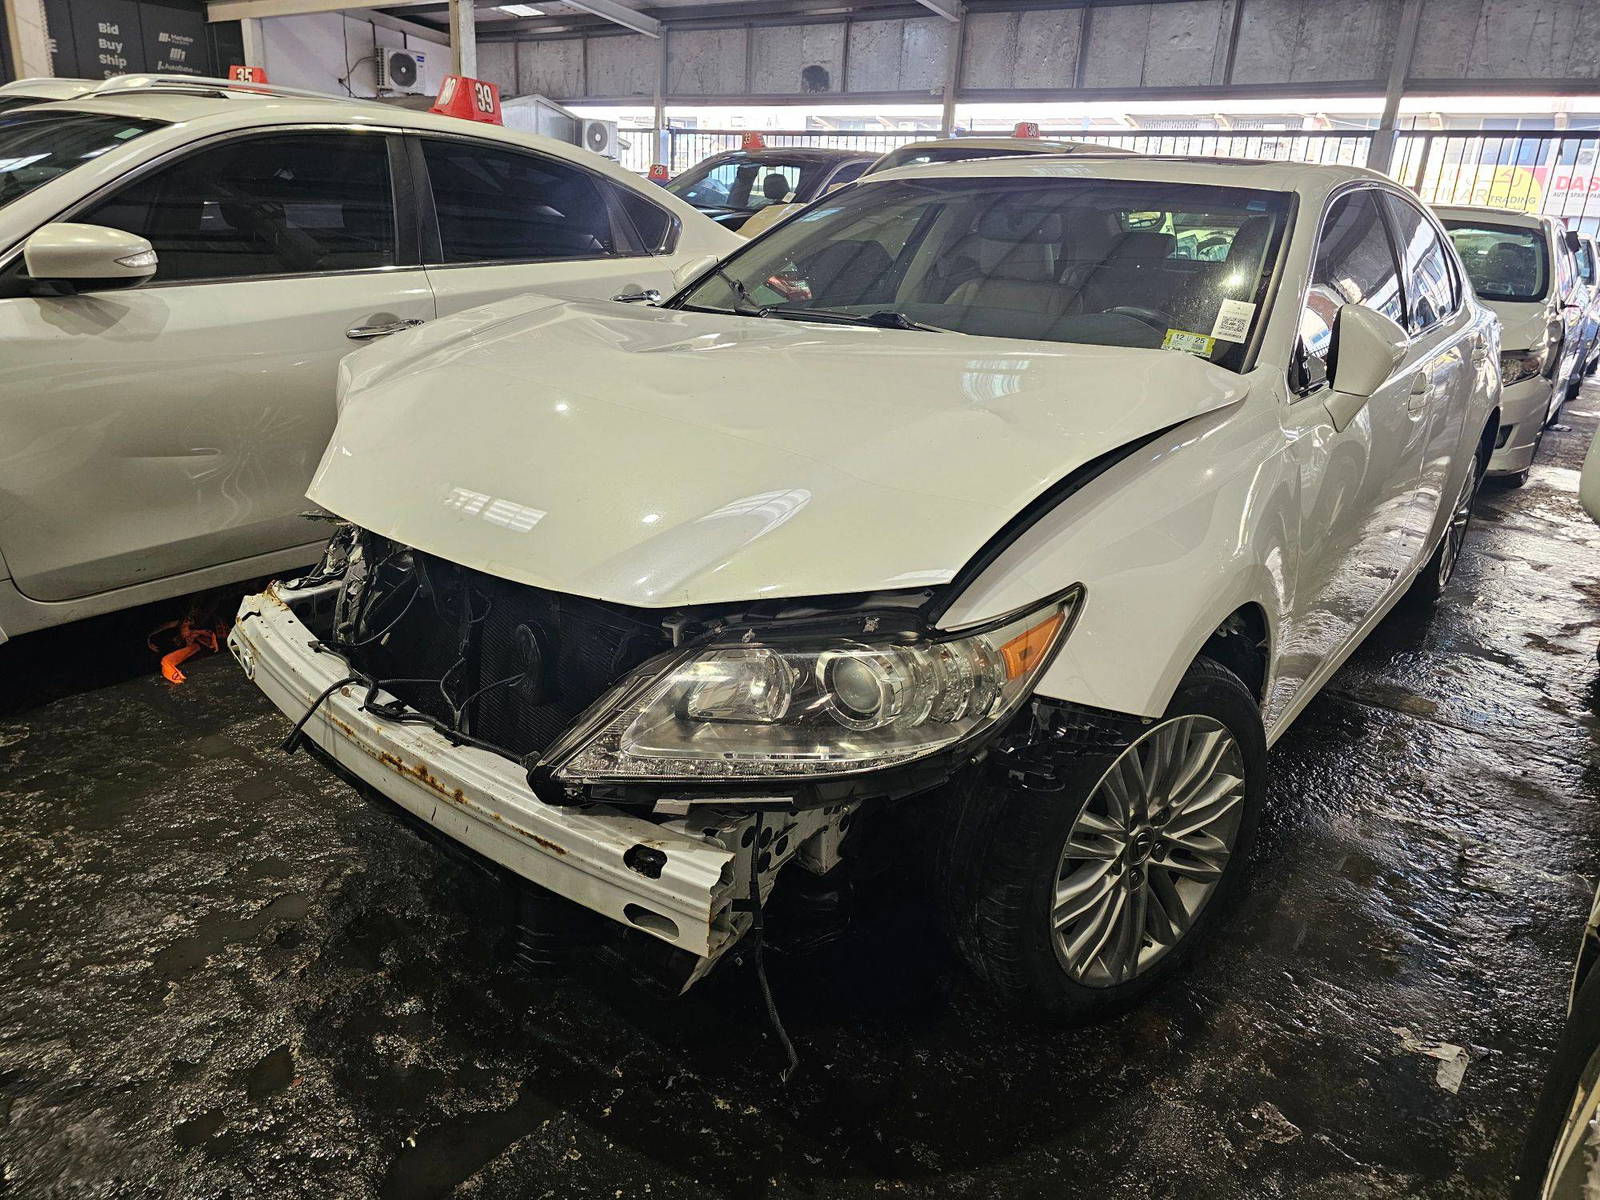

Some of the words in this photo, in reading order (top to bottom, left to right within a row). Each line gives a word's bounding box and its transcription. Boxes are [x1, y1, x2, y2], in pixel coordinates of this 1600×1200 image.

[98, 22, 119, 35] Bid
[98, 38, 123, 53] Buy
[99, 54, 127, 69] Ship
[236, 68, 253, 82] 35
[475, 82, 494, 113] 39
